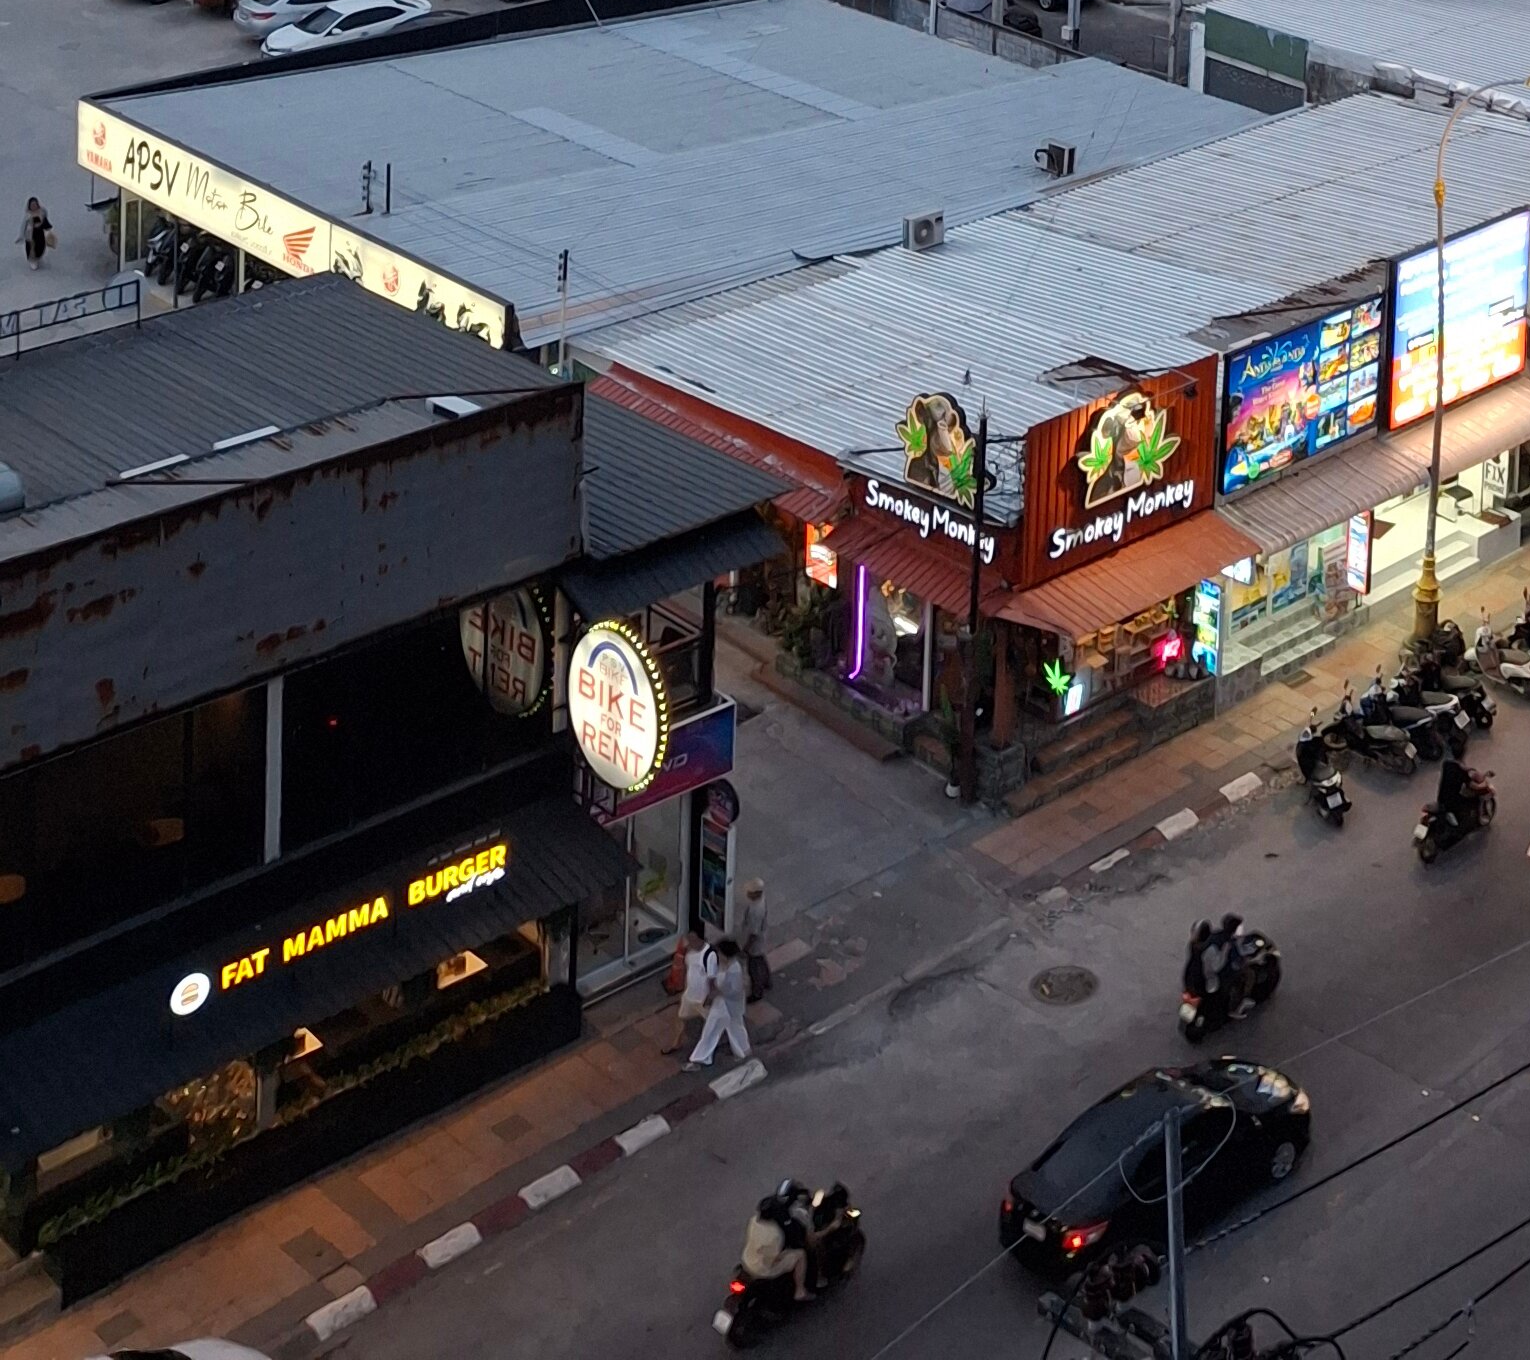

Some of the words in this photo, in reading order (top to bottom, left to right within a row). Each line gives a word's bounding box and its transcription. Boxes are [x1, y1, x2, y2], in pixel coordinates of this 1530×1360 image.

[86, 149, 113, 174] YAMAHA
[122, 136, 181, 198] APSV
[282, 252, 316, 275] HONDA
[1484, 461, 1507, 486] FIX
[865, 478, 930, 539] Smokey
[1049, 511, 1124, 560] Smokey
[1126, 478, 1195, 525] Monkey
[578, 667, 647, 733] BIKE
[600, 713, 623, 738] FOR
[582, 719, 645, 779] RENT
[221, 947, 271, 991] FAT
[282, 896, 390, 964] MAMMA
[407, 844, 508, 906] BURGER
